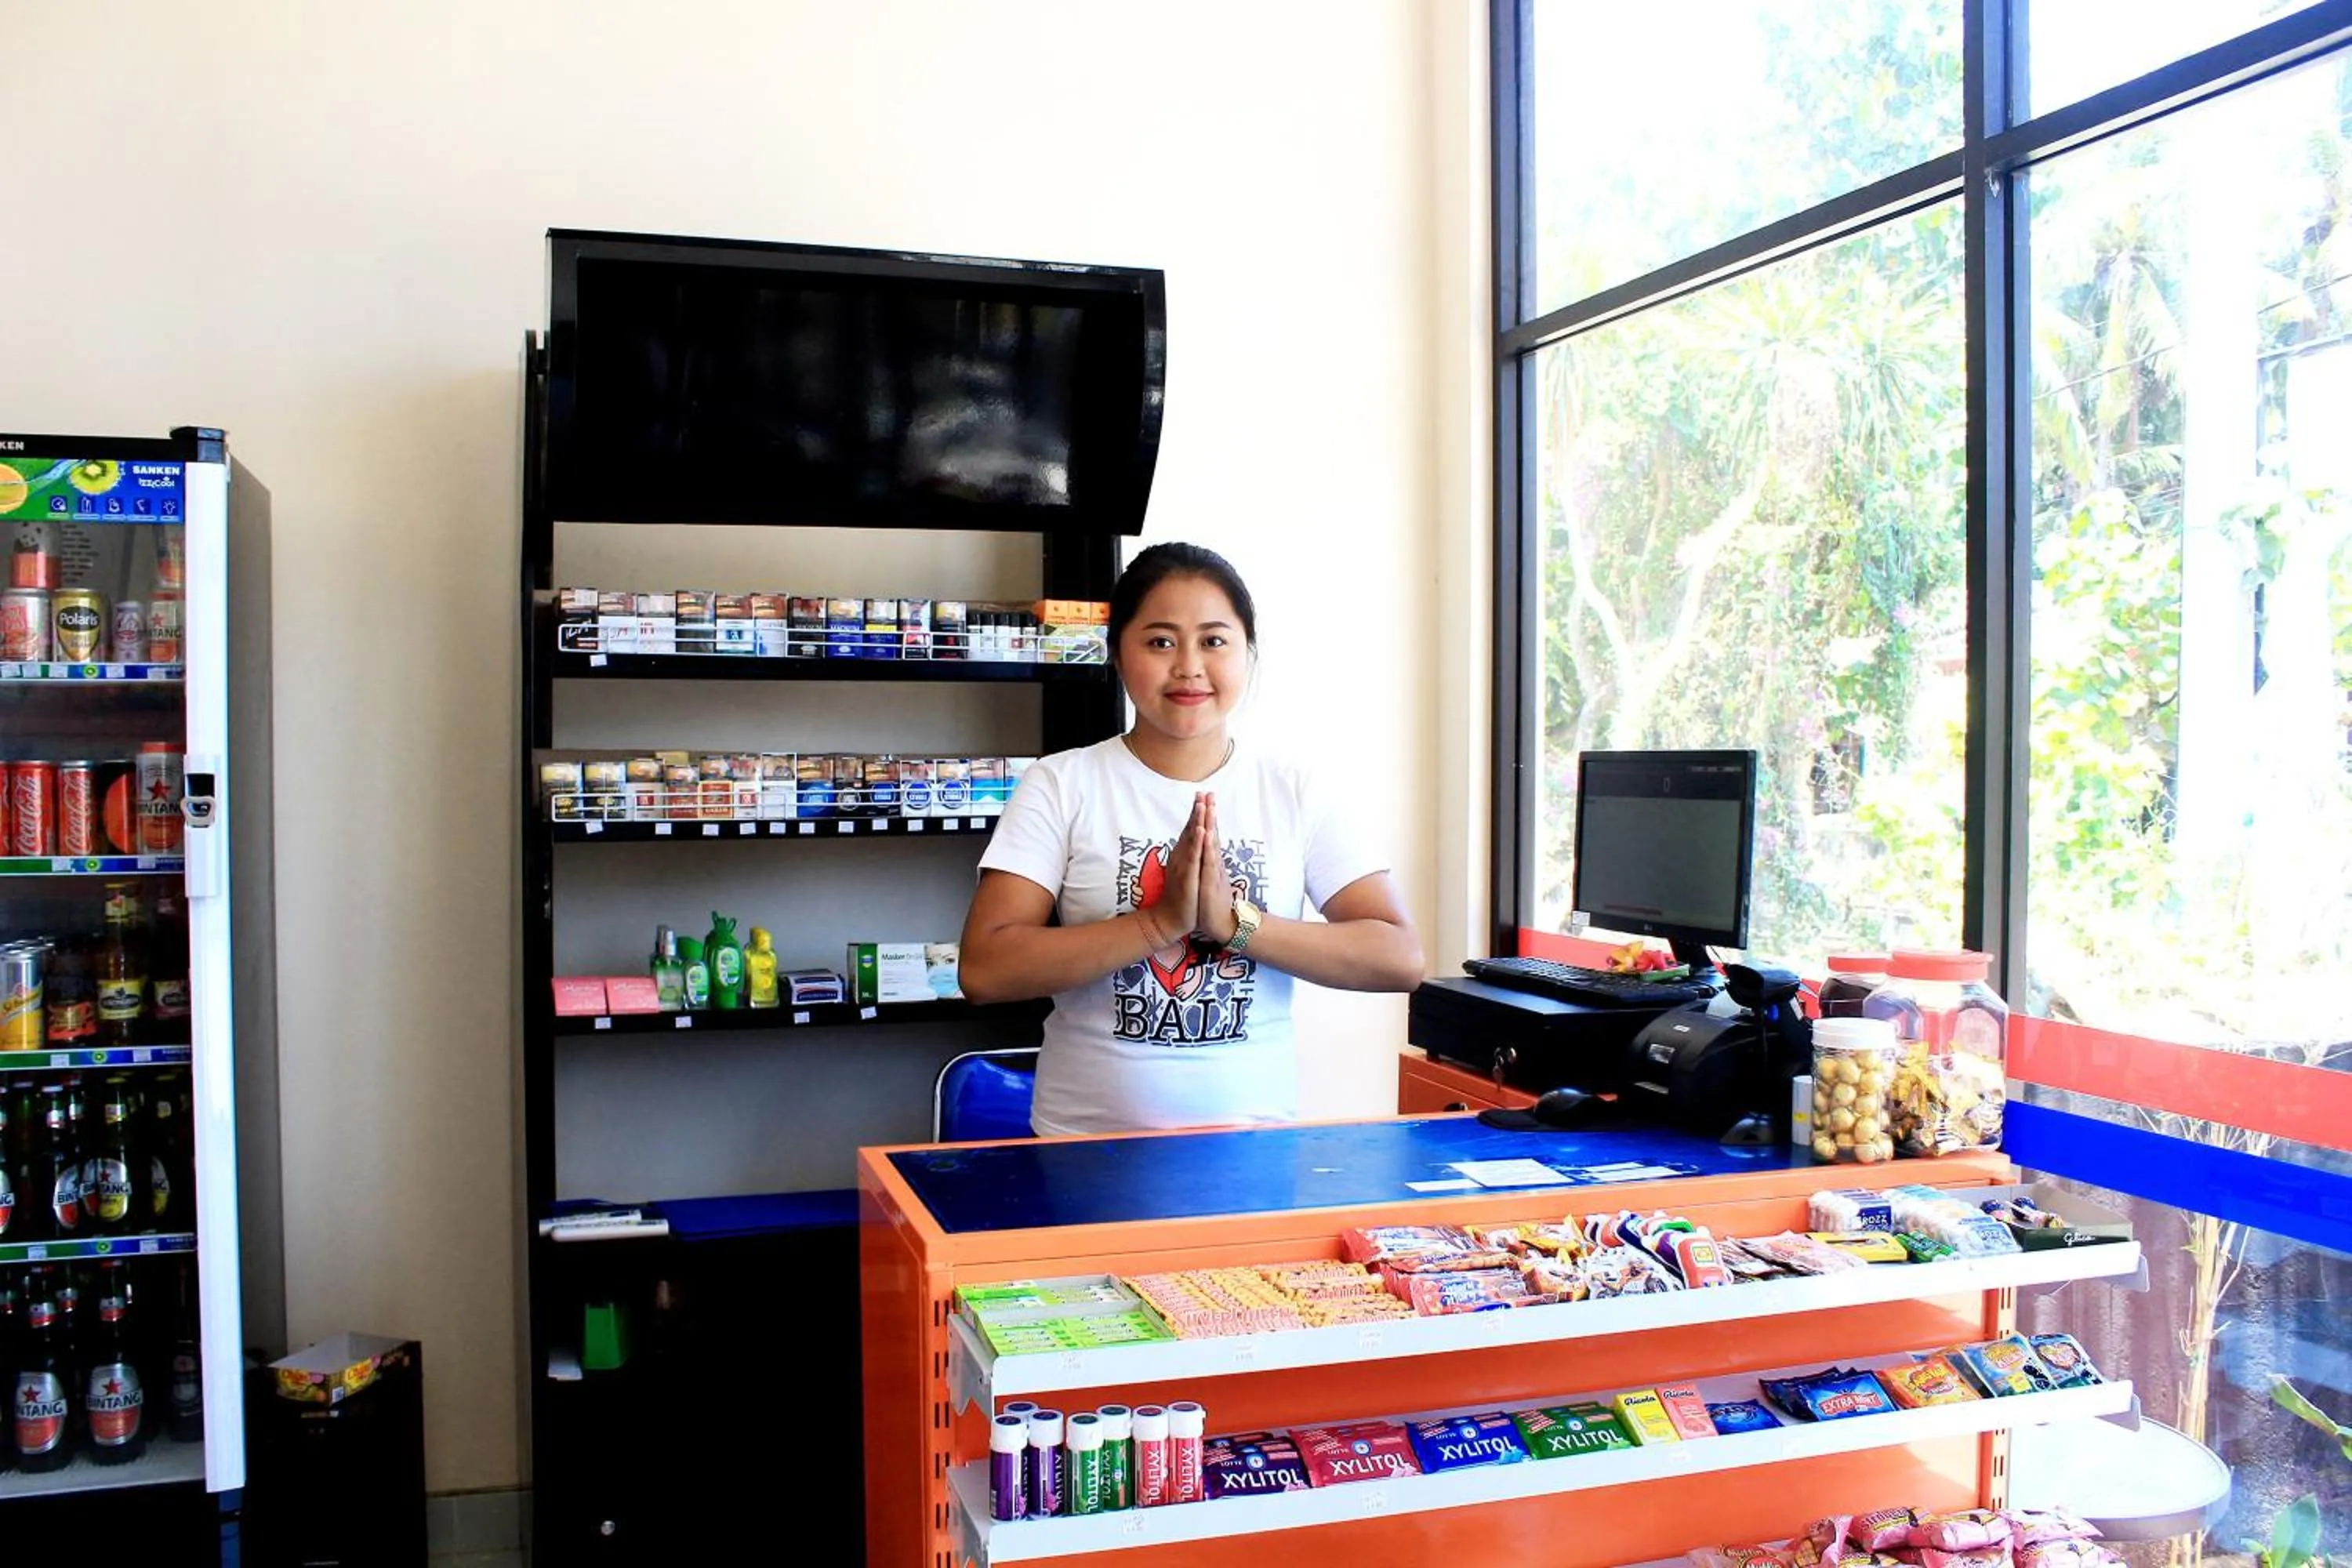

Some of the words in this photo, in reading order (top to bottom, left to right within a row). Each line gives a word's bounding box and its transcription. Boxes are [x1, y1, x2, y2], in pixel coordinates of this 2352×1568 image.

[132, 465, 180, 476] SANKEN
[60, 612, 98, 626] Polaris
[1114, 993, 1250, 1044] BALI
[88, 1392, 141, 1410] BINTANG
[1438, 1436, 1517, 1461] XYLITOL
[1546, 1428, 1624, 1452] XYLITOL
[1181, 1447, 1194, 1501] XYLITOL
[1329, 1453, 1410, 1476] XYLITOL
[1087, 1459, 1098, 1512] XYLITOL
[1149, 1450, 1161, 1504] XYLITOL
[1221, 1468, 1304, 1489] XYLITOL
